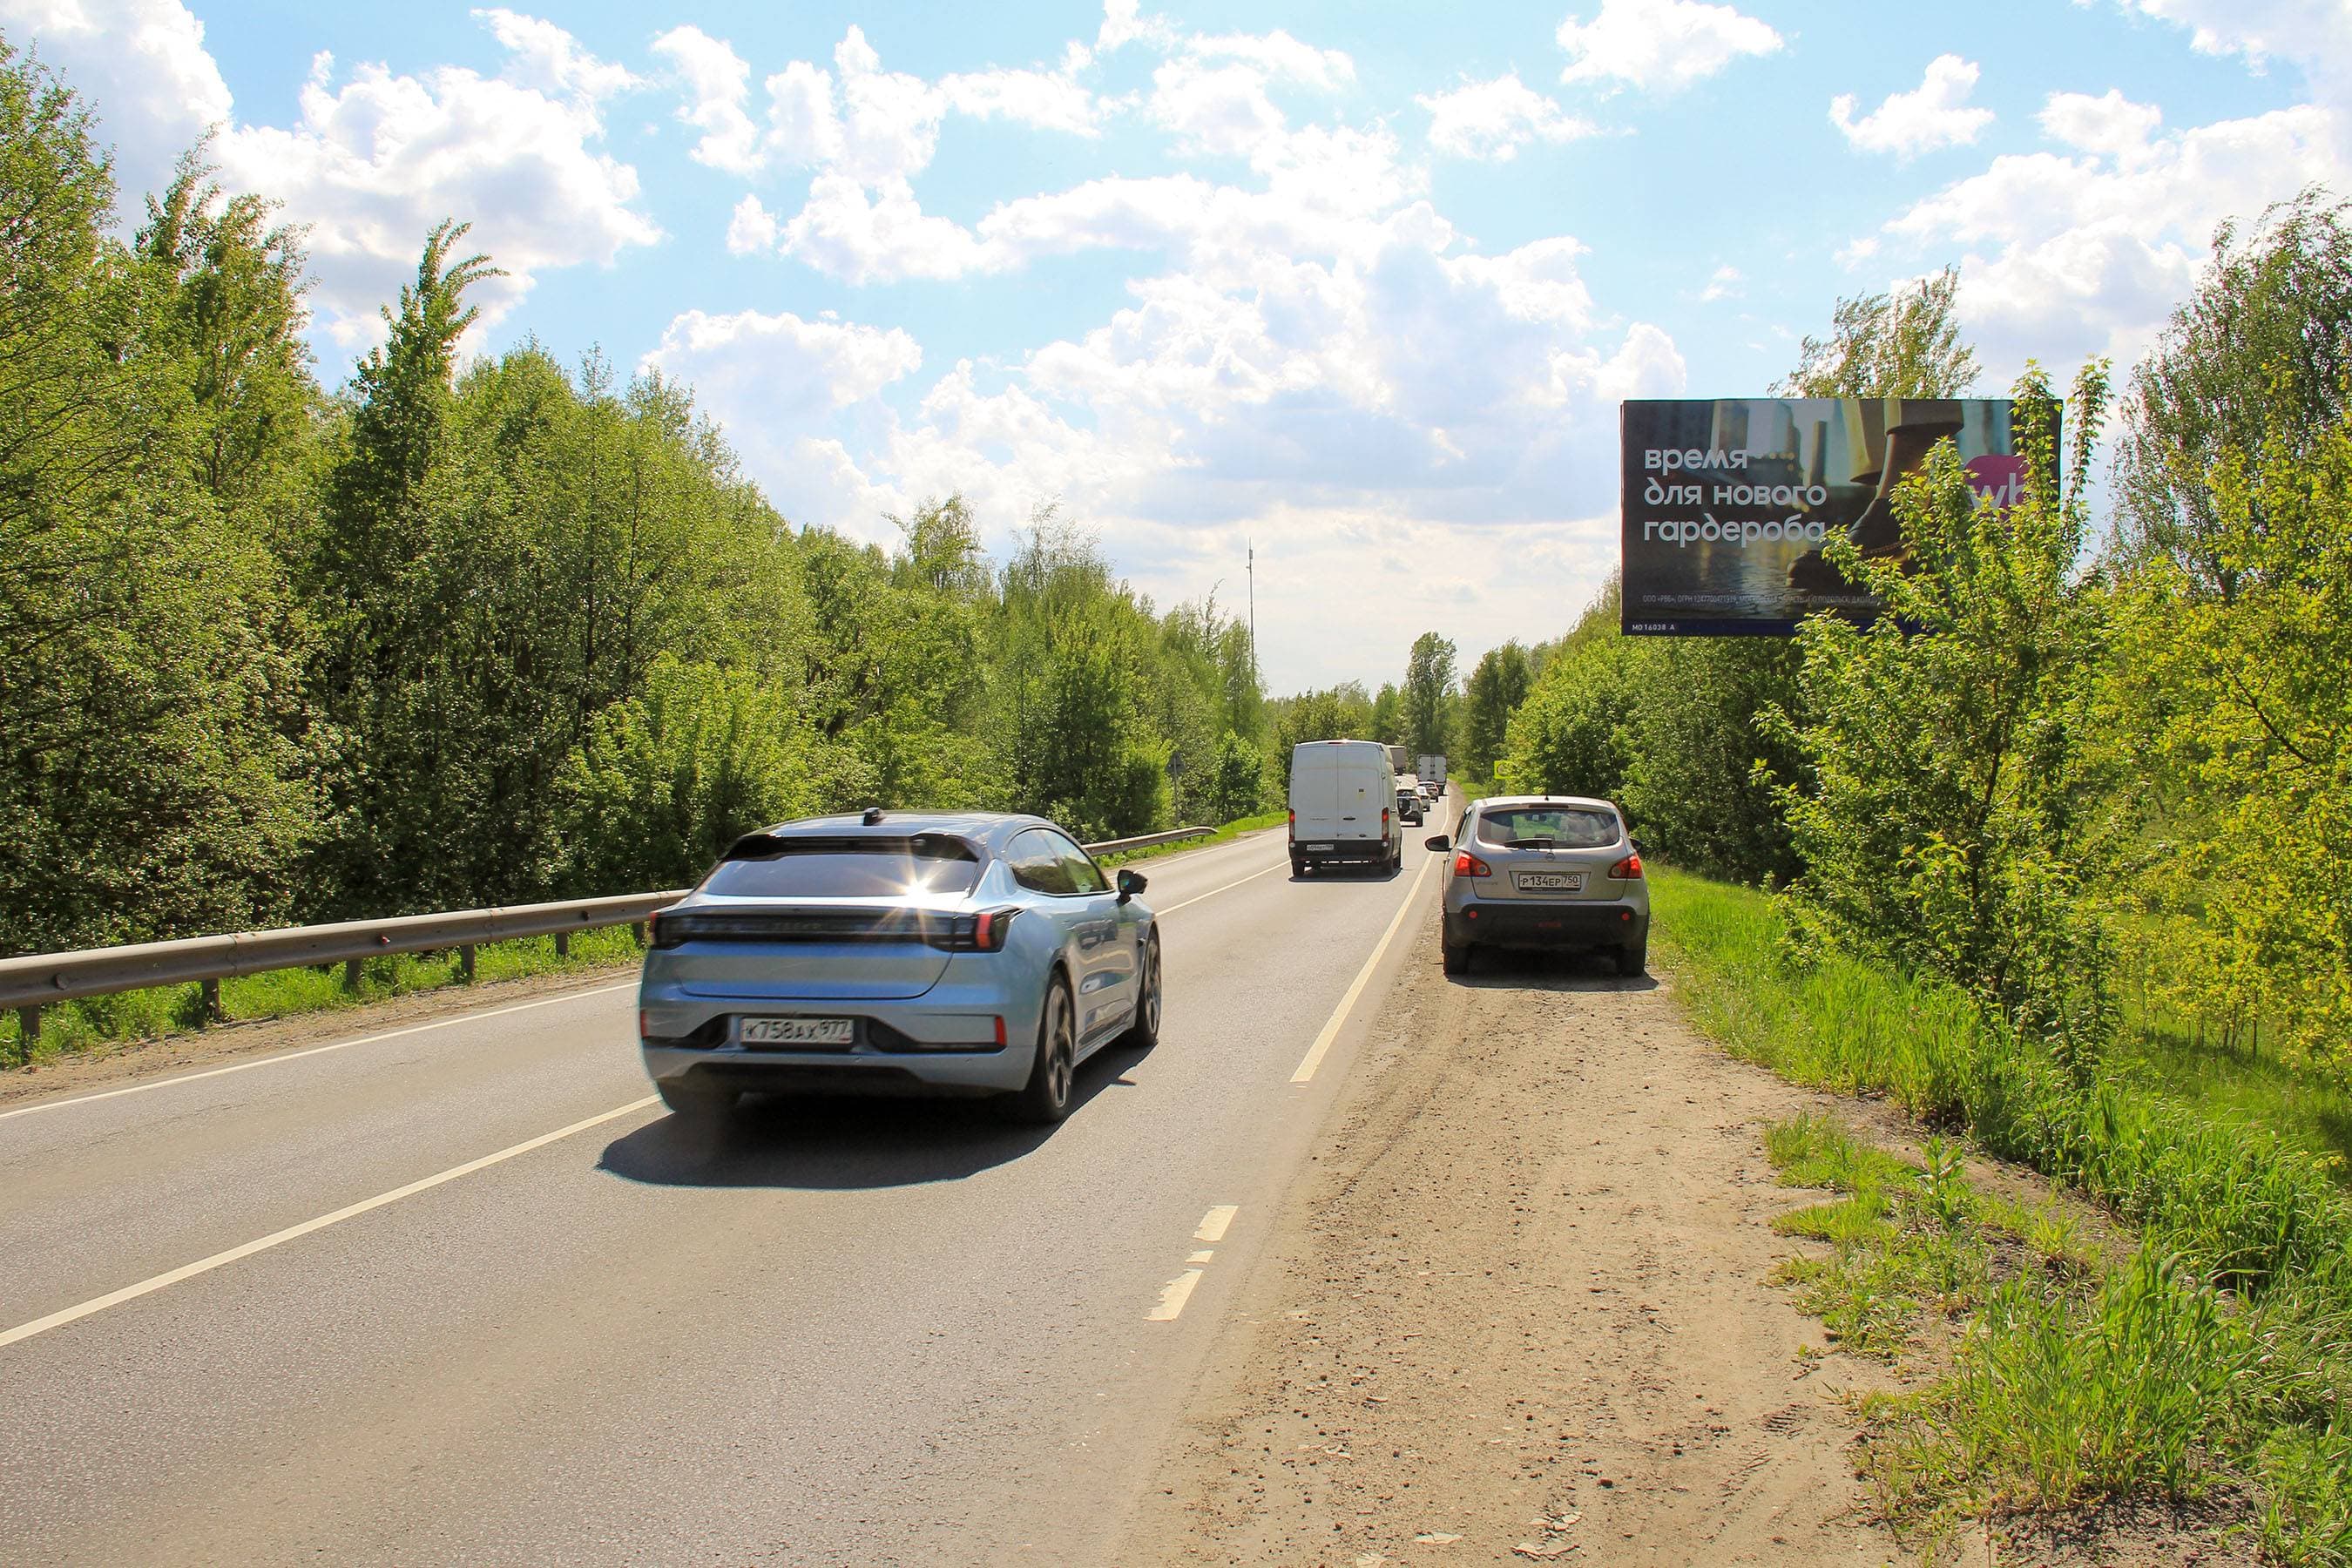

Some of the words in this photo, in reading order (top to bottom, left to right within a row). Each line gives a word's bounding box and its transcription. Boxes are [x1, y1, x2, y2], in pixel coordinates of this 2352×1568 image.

[1645, 449, 1747, 476] время
[1644, 476, 1702, 505] для
[1713, 485, 1828, 506] нового
[1644, 513, 1826, 548] гардероба
